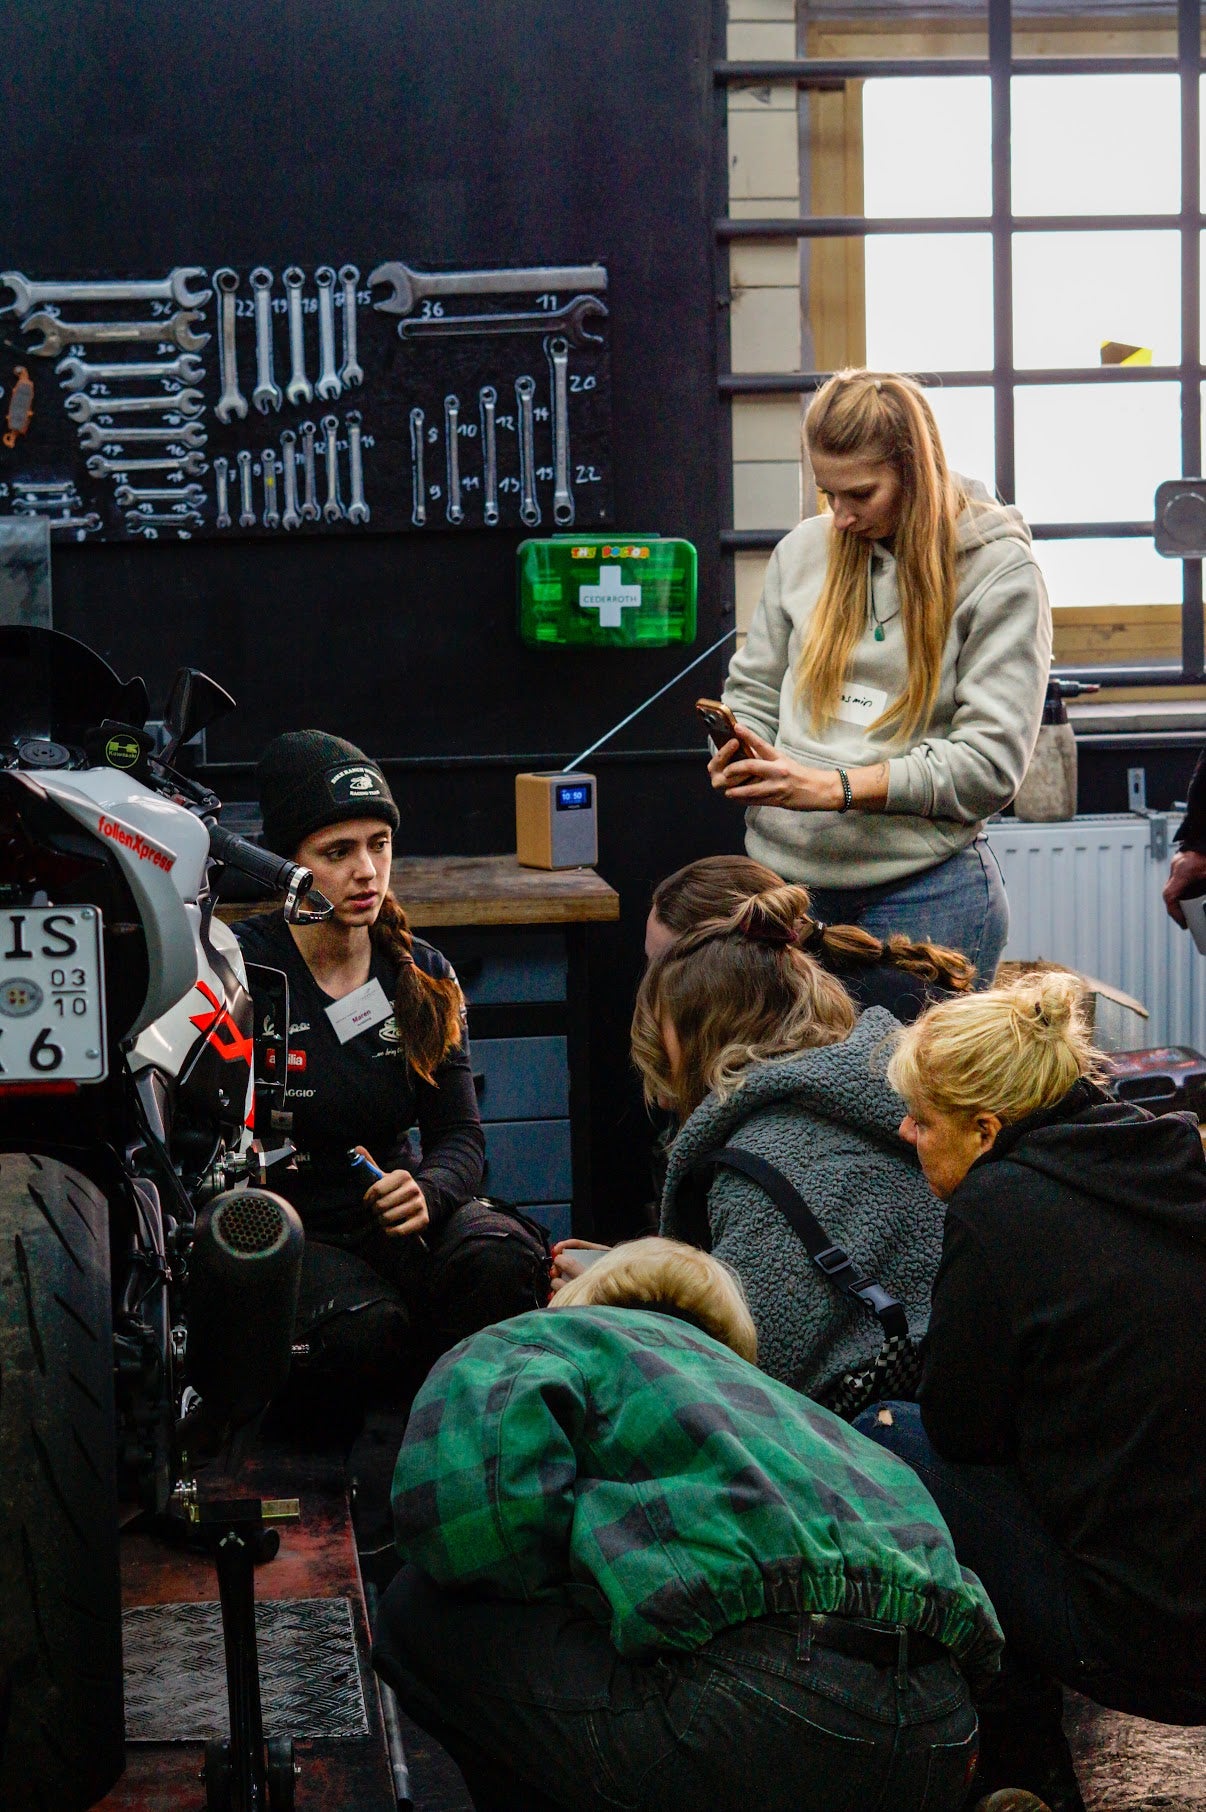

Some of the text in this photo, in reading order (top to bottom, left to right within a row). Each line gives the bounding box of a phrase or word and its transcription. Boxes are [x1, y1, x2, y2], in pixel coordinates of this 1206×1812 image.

[355, 290, 373, 305] 15
[235, 299, 255, 317] 22
[271, 298, 288, 314] 19
[301, 298, 318, 314] 18
[421, 300, 445, 322] 36
[570, 375, 597, 392] 20
[457, 424, 477, 437] 10
[495, 416, 515, 431] 12
[575, 465, 602, 484] 22
[499, 482, 520, 493] 13
[583, 595, 637, 604] CEDERROTH
[51, 968, 87, 987] 03
[54, 997, 87, 1017] 10
